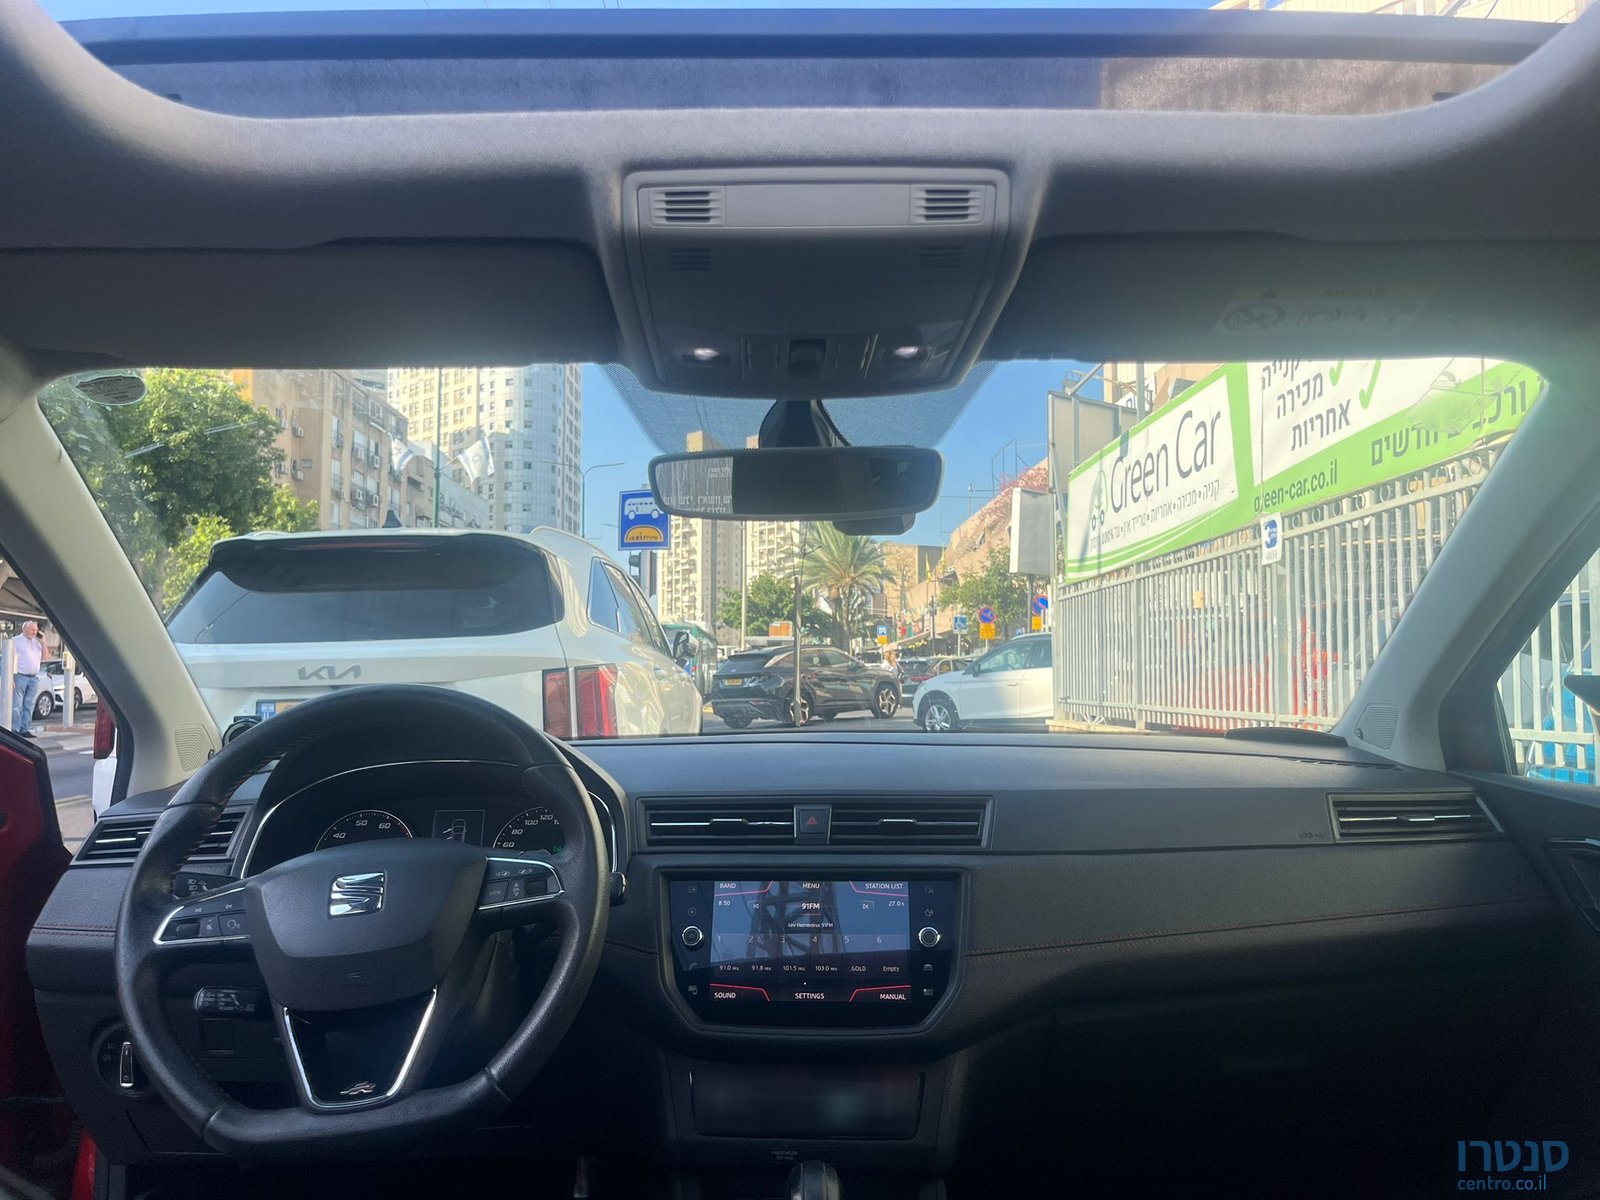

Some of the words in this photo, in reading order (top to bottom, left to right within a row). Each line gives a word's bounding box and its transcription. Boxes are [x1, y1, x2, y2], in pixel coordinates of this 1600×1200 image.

[1277, 372, 1324, 420] מכירה
[1291, 398, 1352, 452] אחריות
[1111, 443, 1169, 514] Green
[1176, 410, 1221, 479] Car
[1202, 479, 1220, 501] קניה
[1254, 458, 1338, 513] geen-car.co.il
[1176, 489, 1197, 511] מכירה
[1150, 503, 1173, 524] אחריות
[297, 664, 362, 681] KIA
[749, 935, 754, 943] 2
[781, 935, 786, 943] 3
[812, 935, 818, 943] 4
[844, 935, 850, 943] 5
[876, 935, 882, 943] 6
[882, 965, 900, 973] Empty
